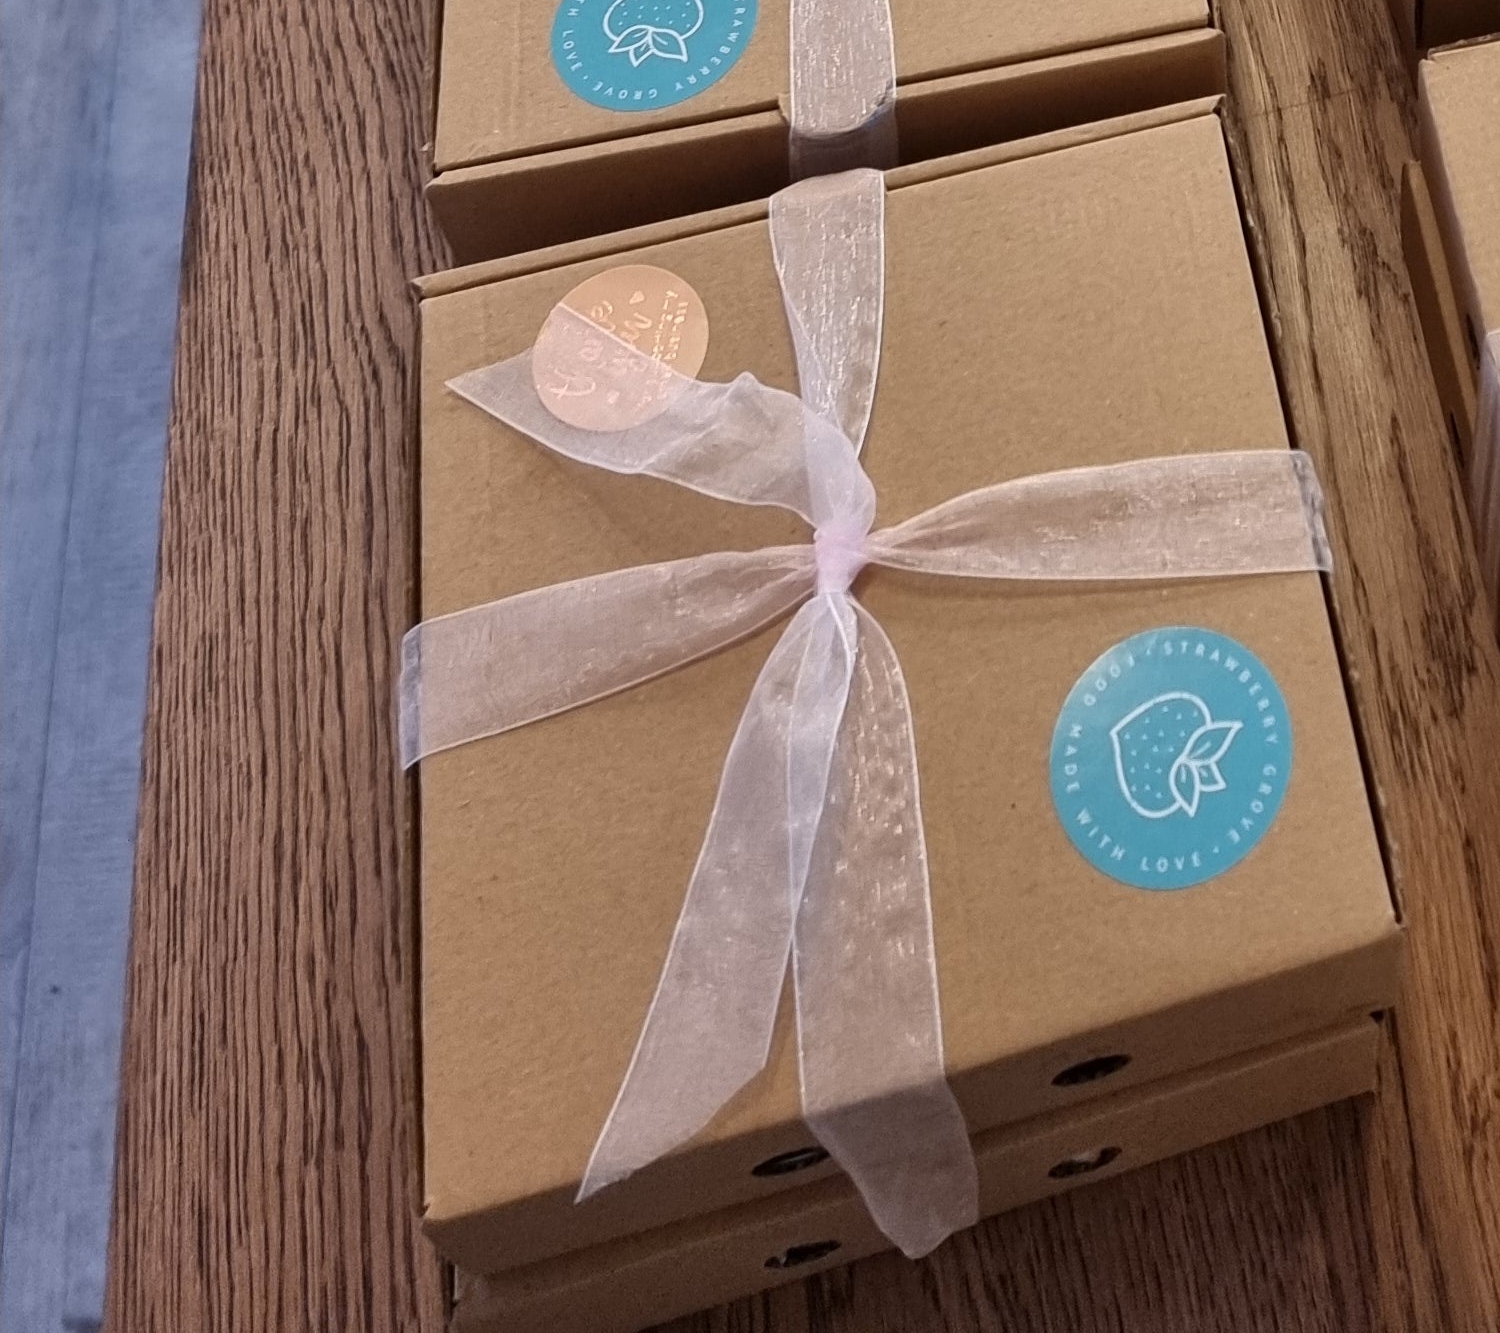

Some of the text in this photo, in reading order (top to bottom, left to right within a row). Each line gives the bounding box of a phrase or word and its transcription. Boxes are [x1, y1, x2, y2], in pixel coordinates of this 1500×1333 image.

[562, 29, 583, 72] LOVE
[593, 81, 658, 100] GROVE
[1164, 640, 1278, 845] STRAWBERRY GROVE
[1064, 723, 1083, 794] MADE
[1076, 807, 1126, 861] WITH
[1140, 851, 1202, 873] LOVE
